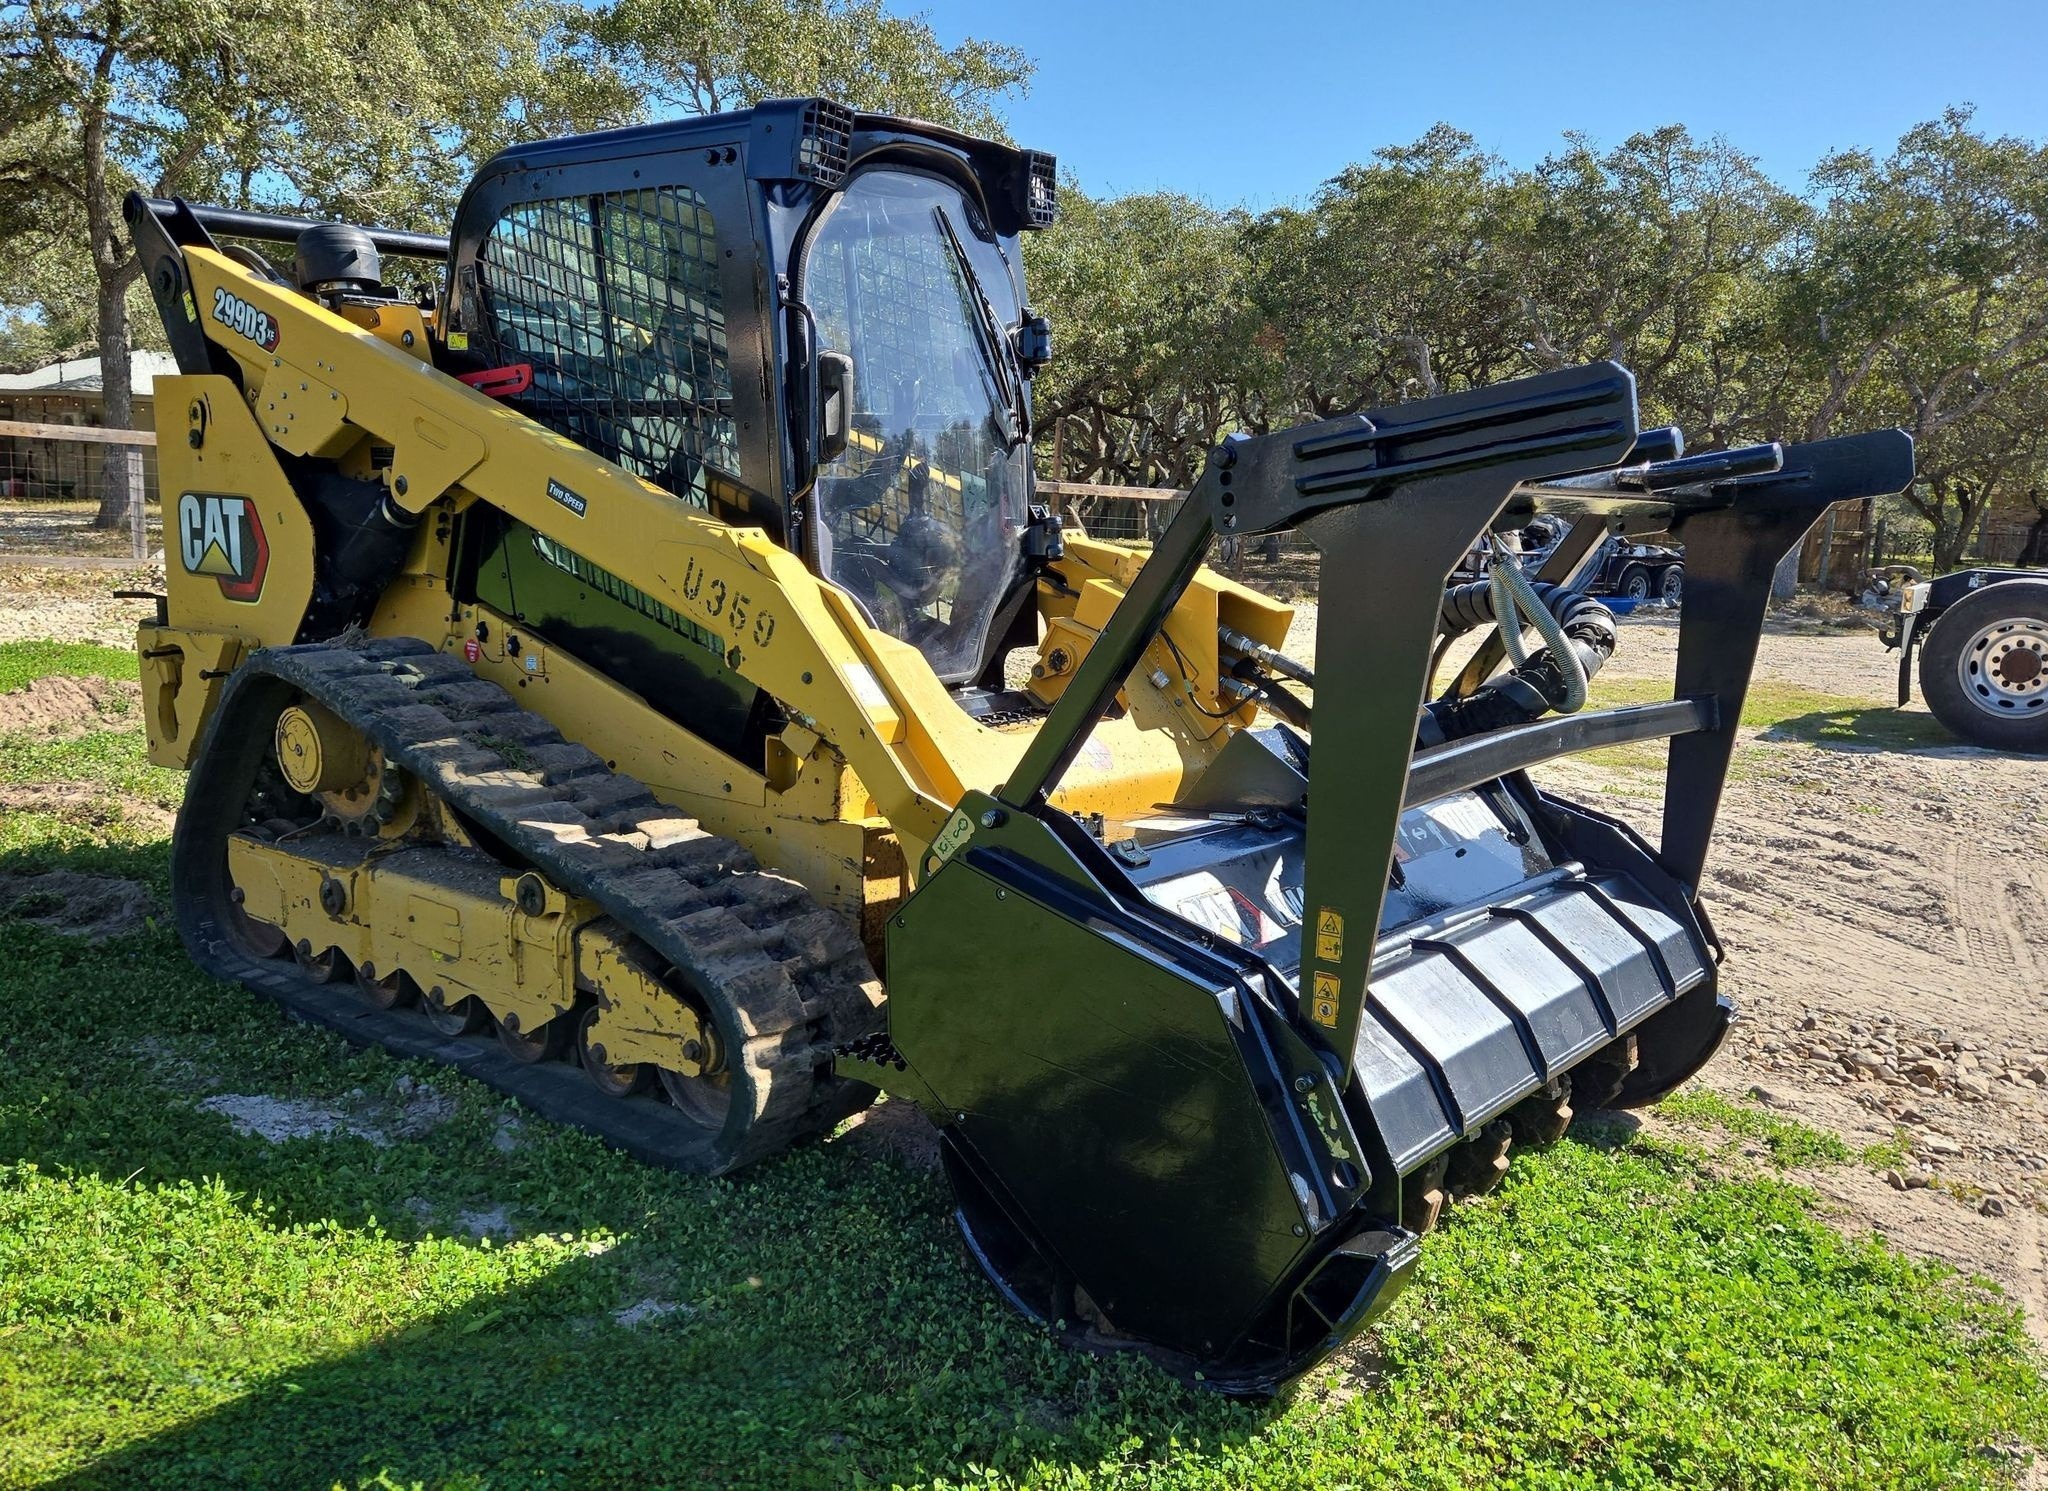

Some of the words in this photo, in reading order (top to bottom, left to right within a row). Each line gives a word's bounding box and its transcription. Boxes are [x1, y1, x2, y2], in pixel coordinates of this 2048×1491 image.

[213, 288, 268, 345] 299D3
[266, 327, 276, 342] XE
[180, 494, 245, 577] CAT
